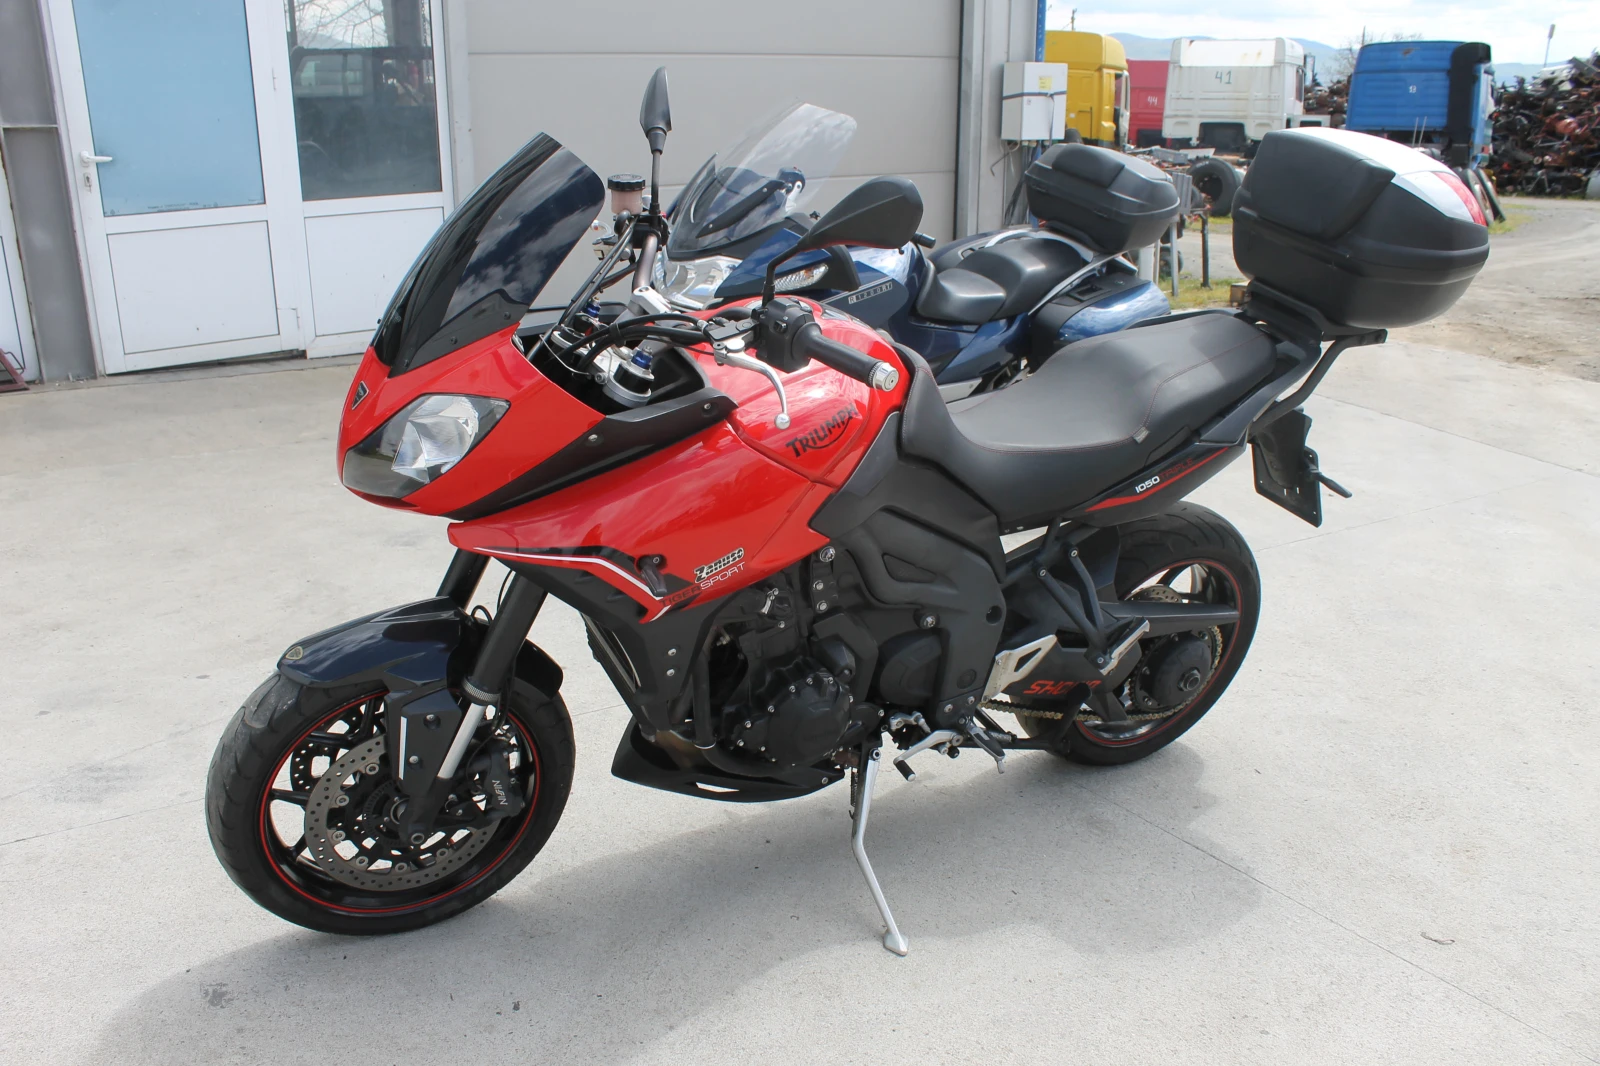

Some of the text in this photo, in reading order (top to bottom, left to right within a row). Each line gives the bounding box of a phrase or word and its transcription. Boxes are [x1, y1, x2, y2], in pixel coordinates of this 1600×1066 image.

[1214, 70, 1233, 85] 41
[785, 402, 859, 458] TRIUMPH
[1134, 475, 1161, 494] 1050
[660, 561, 746, 608] TIGER SPORT
